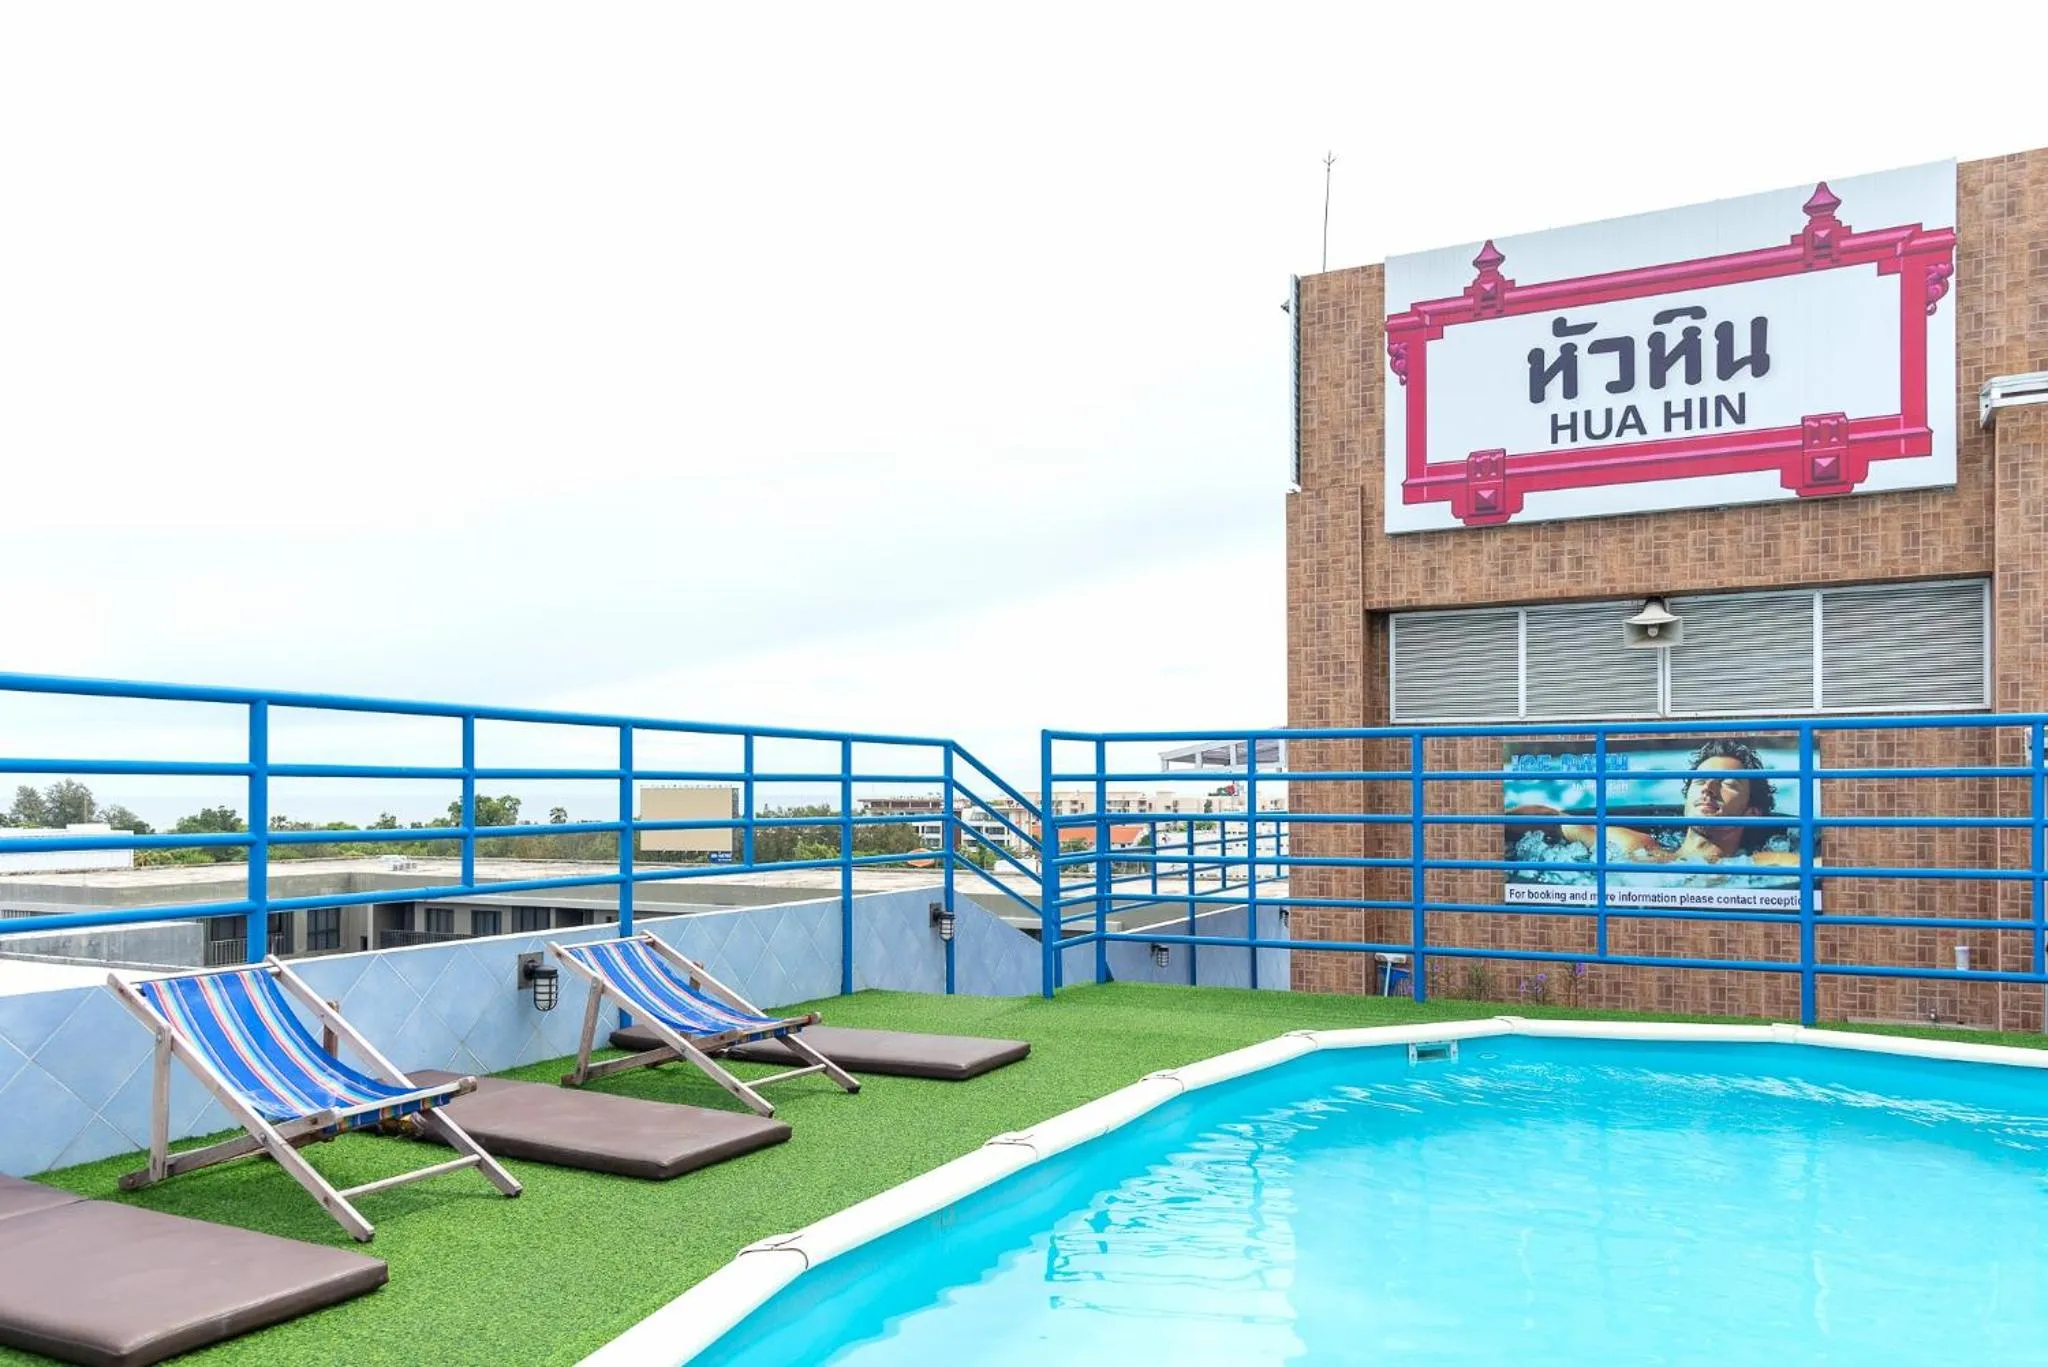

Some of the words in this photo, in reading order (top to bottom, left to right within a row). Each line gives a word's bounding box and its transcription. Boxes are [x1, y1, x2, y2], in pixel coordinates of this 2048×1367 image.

[1527, 305, 1770, 404] หัวหิน
[1551, 405, 1647, 444] HUA
[1664, 392, 1746, 433] HIN
[1509, 888, 1525, 899] For
[1527, 889, 1566, 901] booking
[1569, 891, 1587, 901] and
[1590, 893, 1616, 902] mre
[1618, 891, 1677, 903] information
[1679, 893, 1714, 905] please
[1716, 895, 1757, 906] contact
